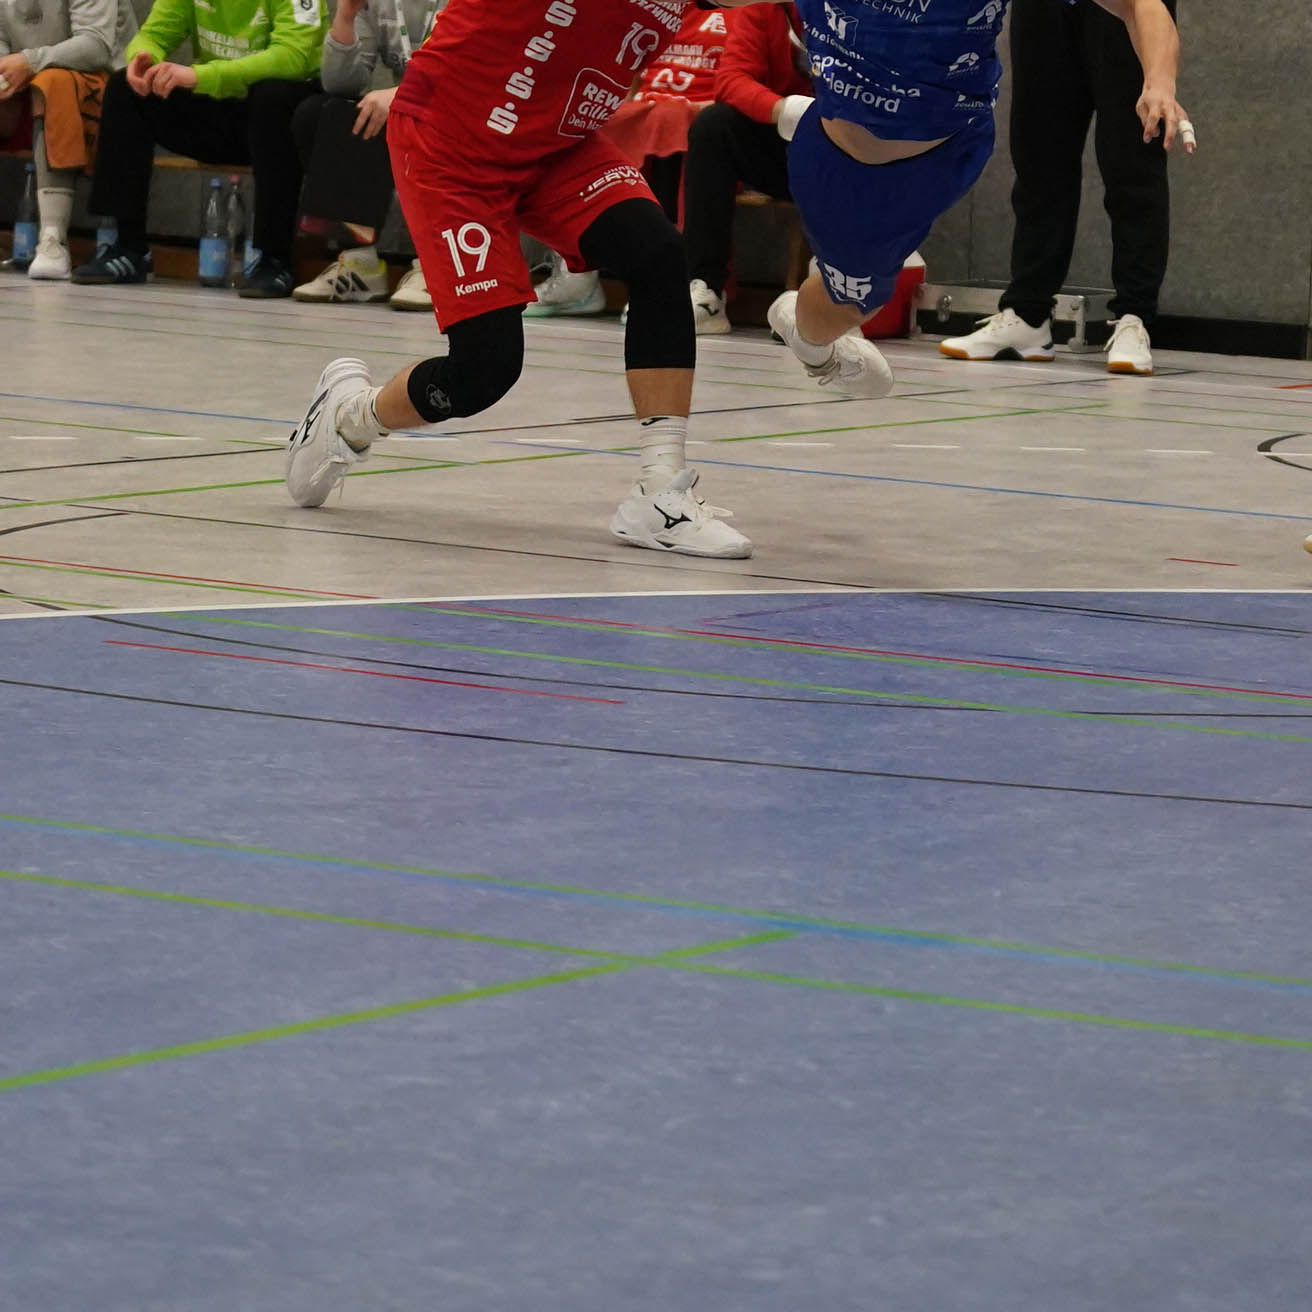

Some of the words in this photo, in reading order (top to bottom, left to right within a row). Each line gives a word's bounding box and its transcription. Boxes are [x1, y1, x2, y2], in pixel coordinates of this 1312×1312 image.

[615, 21, 660, 70] 19
[441, 221, 492, 278] 19
[455, 277, 499, 297] Kempa
[824, 262, 873, 301] 35
